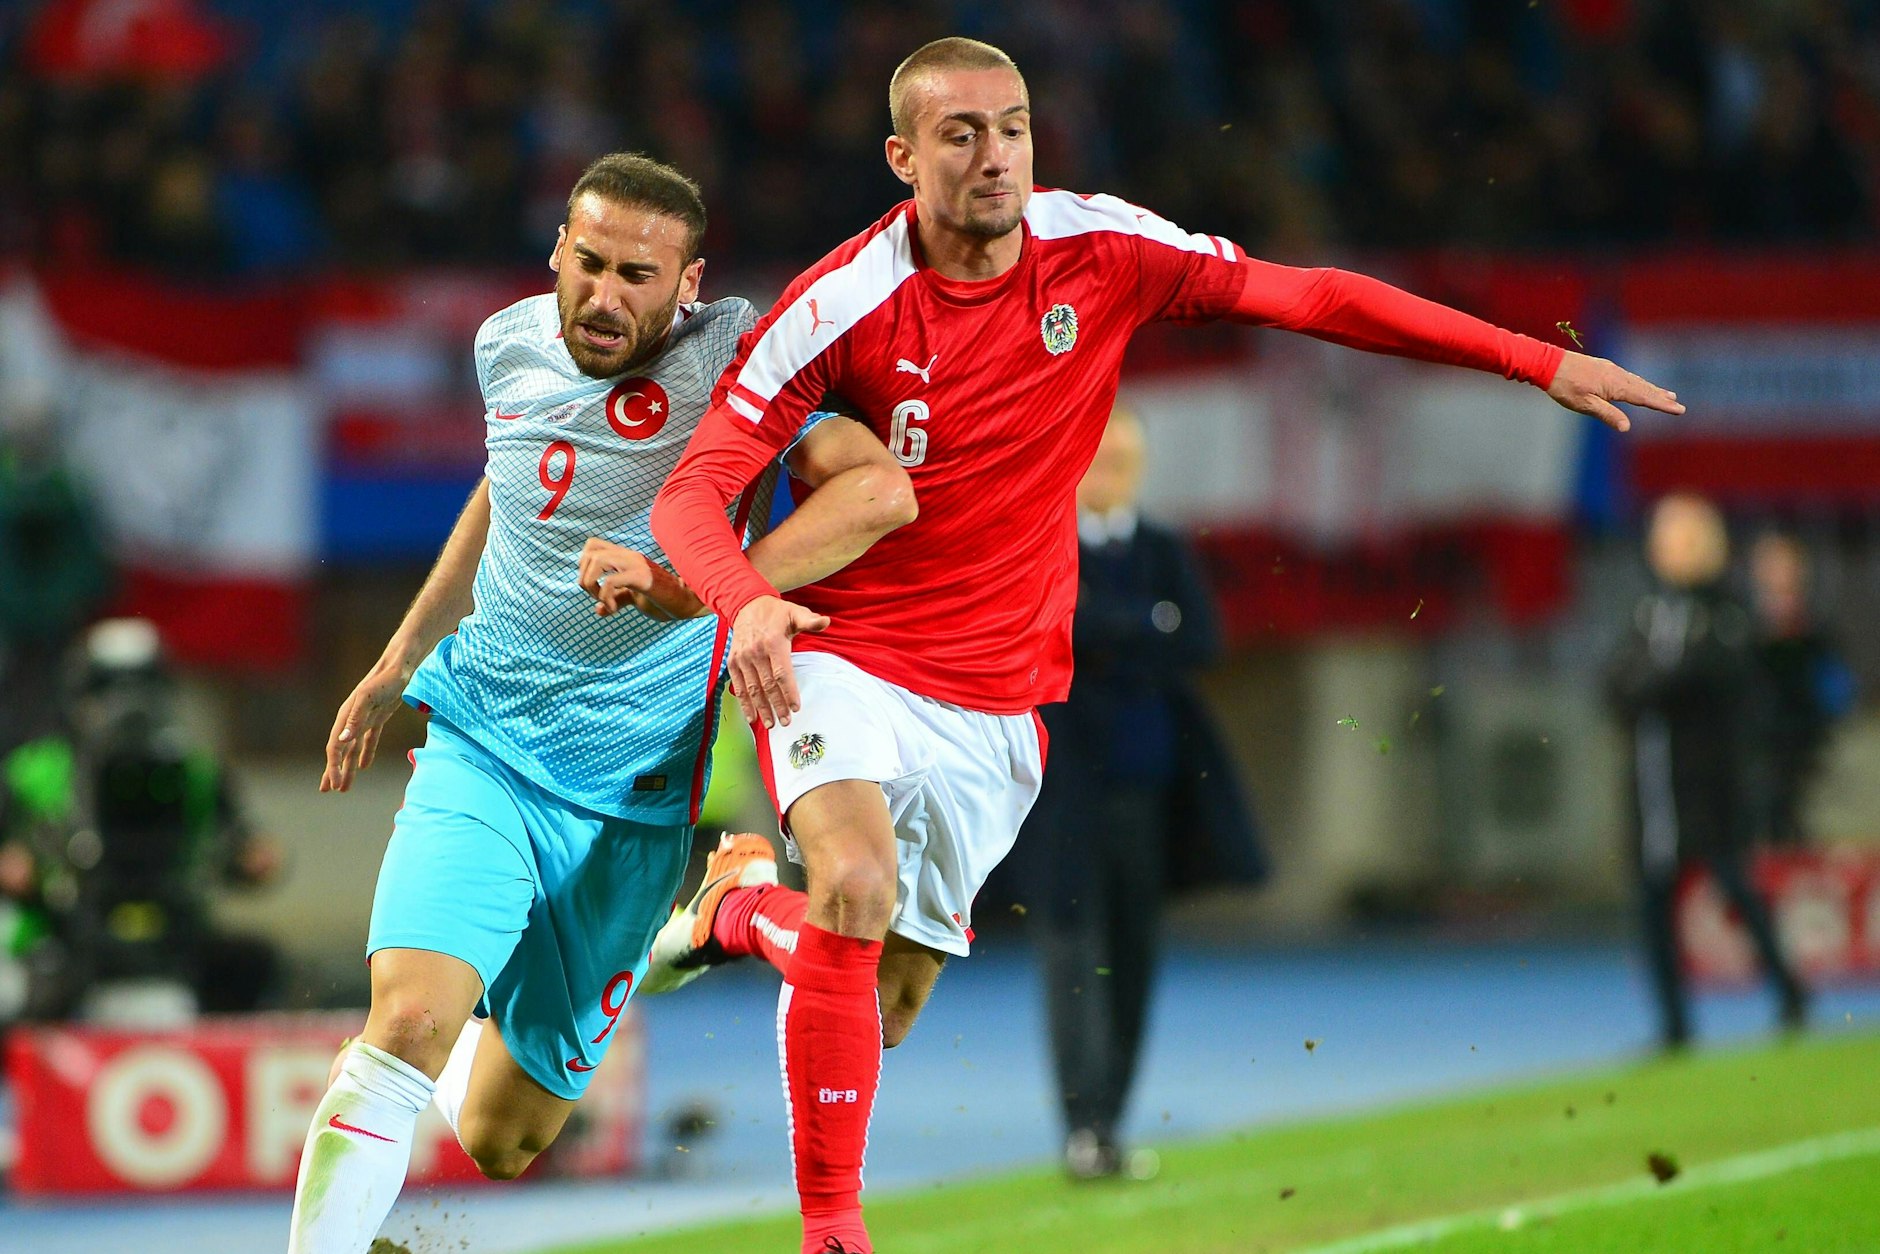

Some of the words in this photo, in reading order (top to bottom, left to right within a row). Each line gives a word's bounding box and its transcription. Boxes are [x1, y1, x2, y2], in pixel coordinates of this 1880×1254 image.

[888, 399, 930, 467] 6
[536, 440, 576, 521] 9
[590, 970, 634, 1044] 9
[818, 1087, 858, 1104] ÖFB
